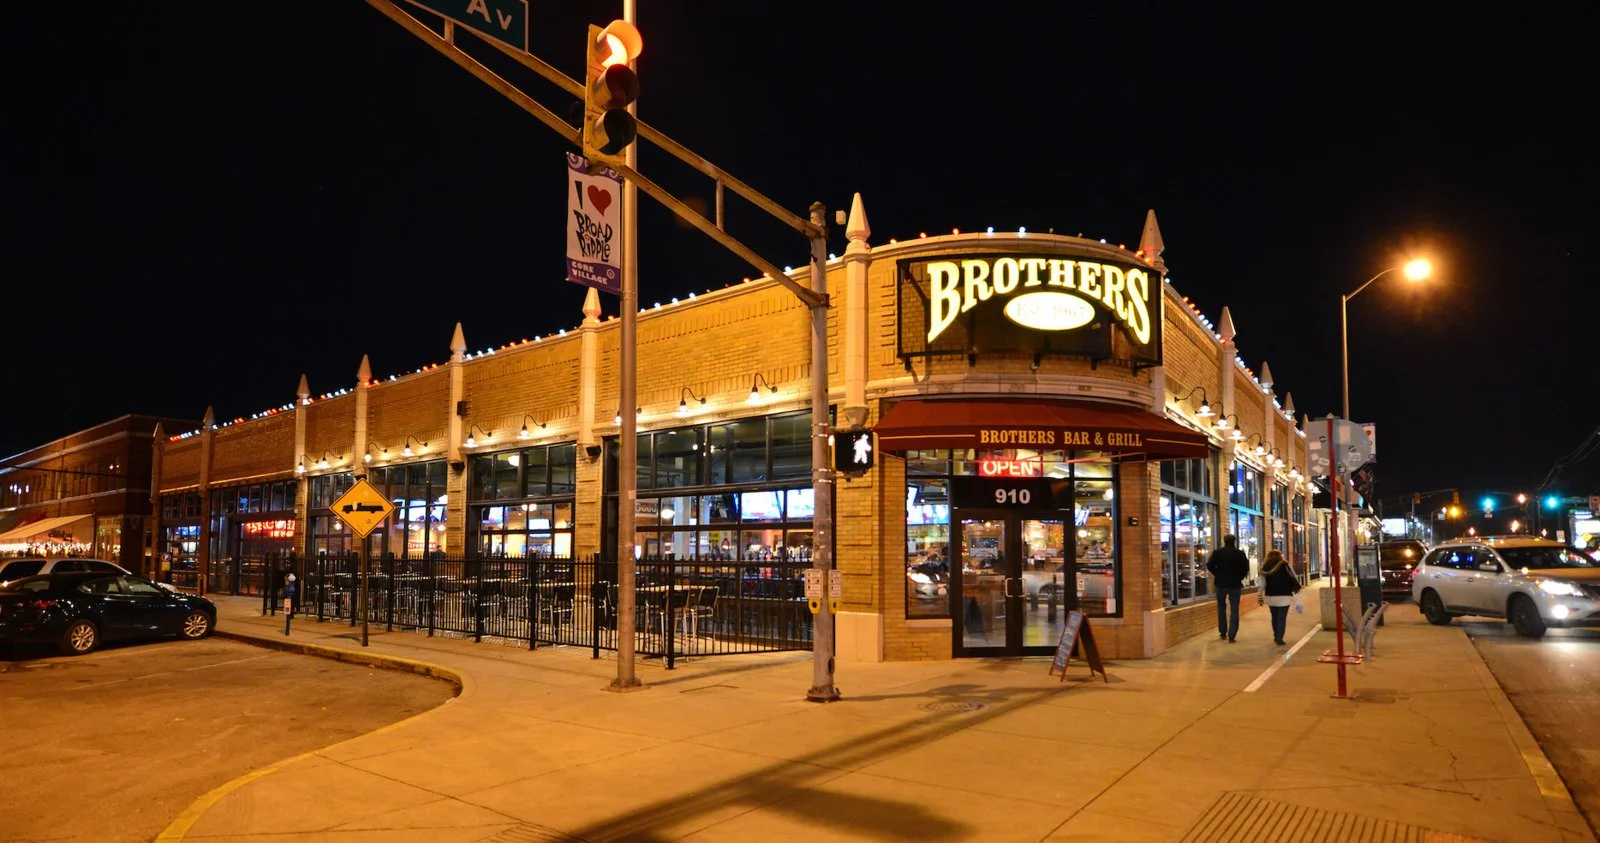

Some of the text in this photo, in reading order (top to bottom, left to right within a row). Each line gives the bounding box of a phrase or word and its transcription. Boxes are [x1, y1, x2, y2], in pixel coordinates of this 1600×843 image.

[466, 0, 512, 31] Av
[575, 180, 583, 210] I
[573, 209, 613, 243] BROAD
[571, 261, 594, 273] CORE
[571, 268, 608, 285] VILLAGE
[927, 257, 1150, 344] BROTHERS
[980, 430, 1142, 446] BROTHERS BAR & GRILL
[983, 460, 1034, 475] OPEN
[995, 488, 1031, 504] 910
